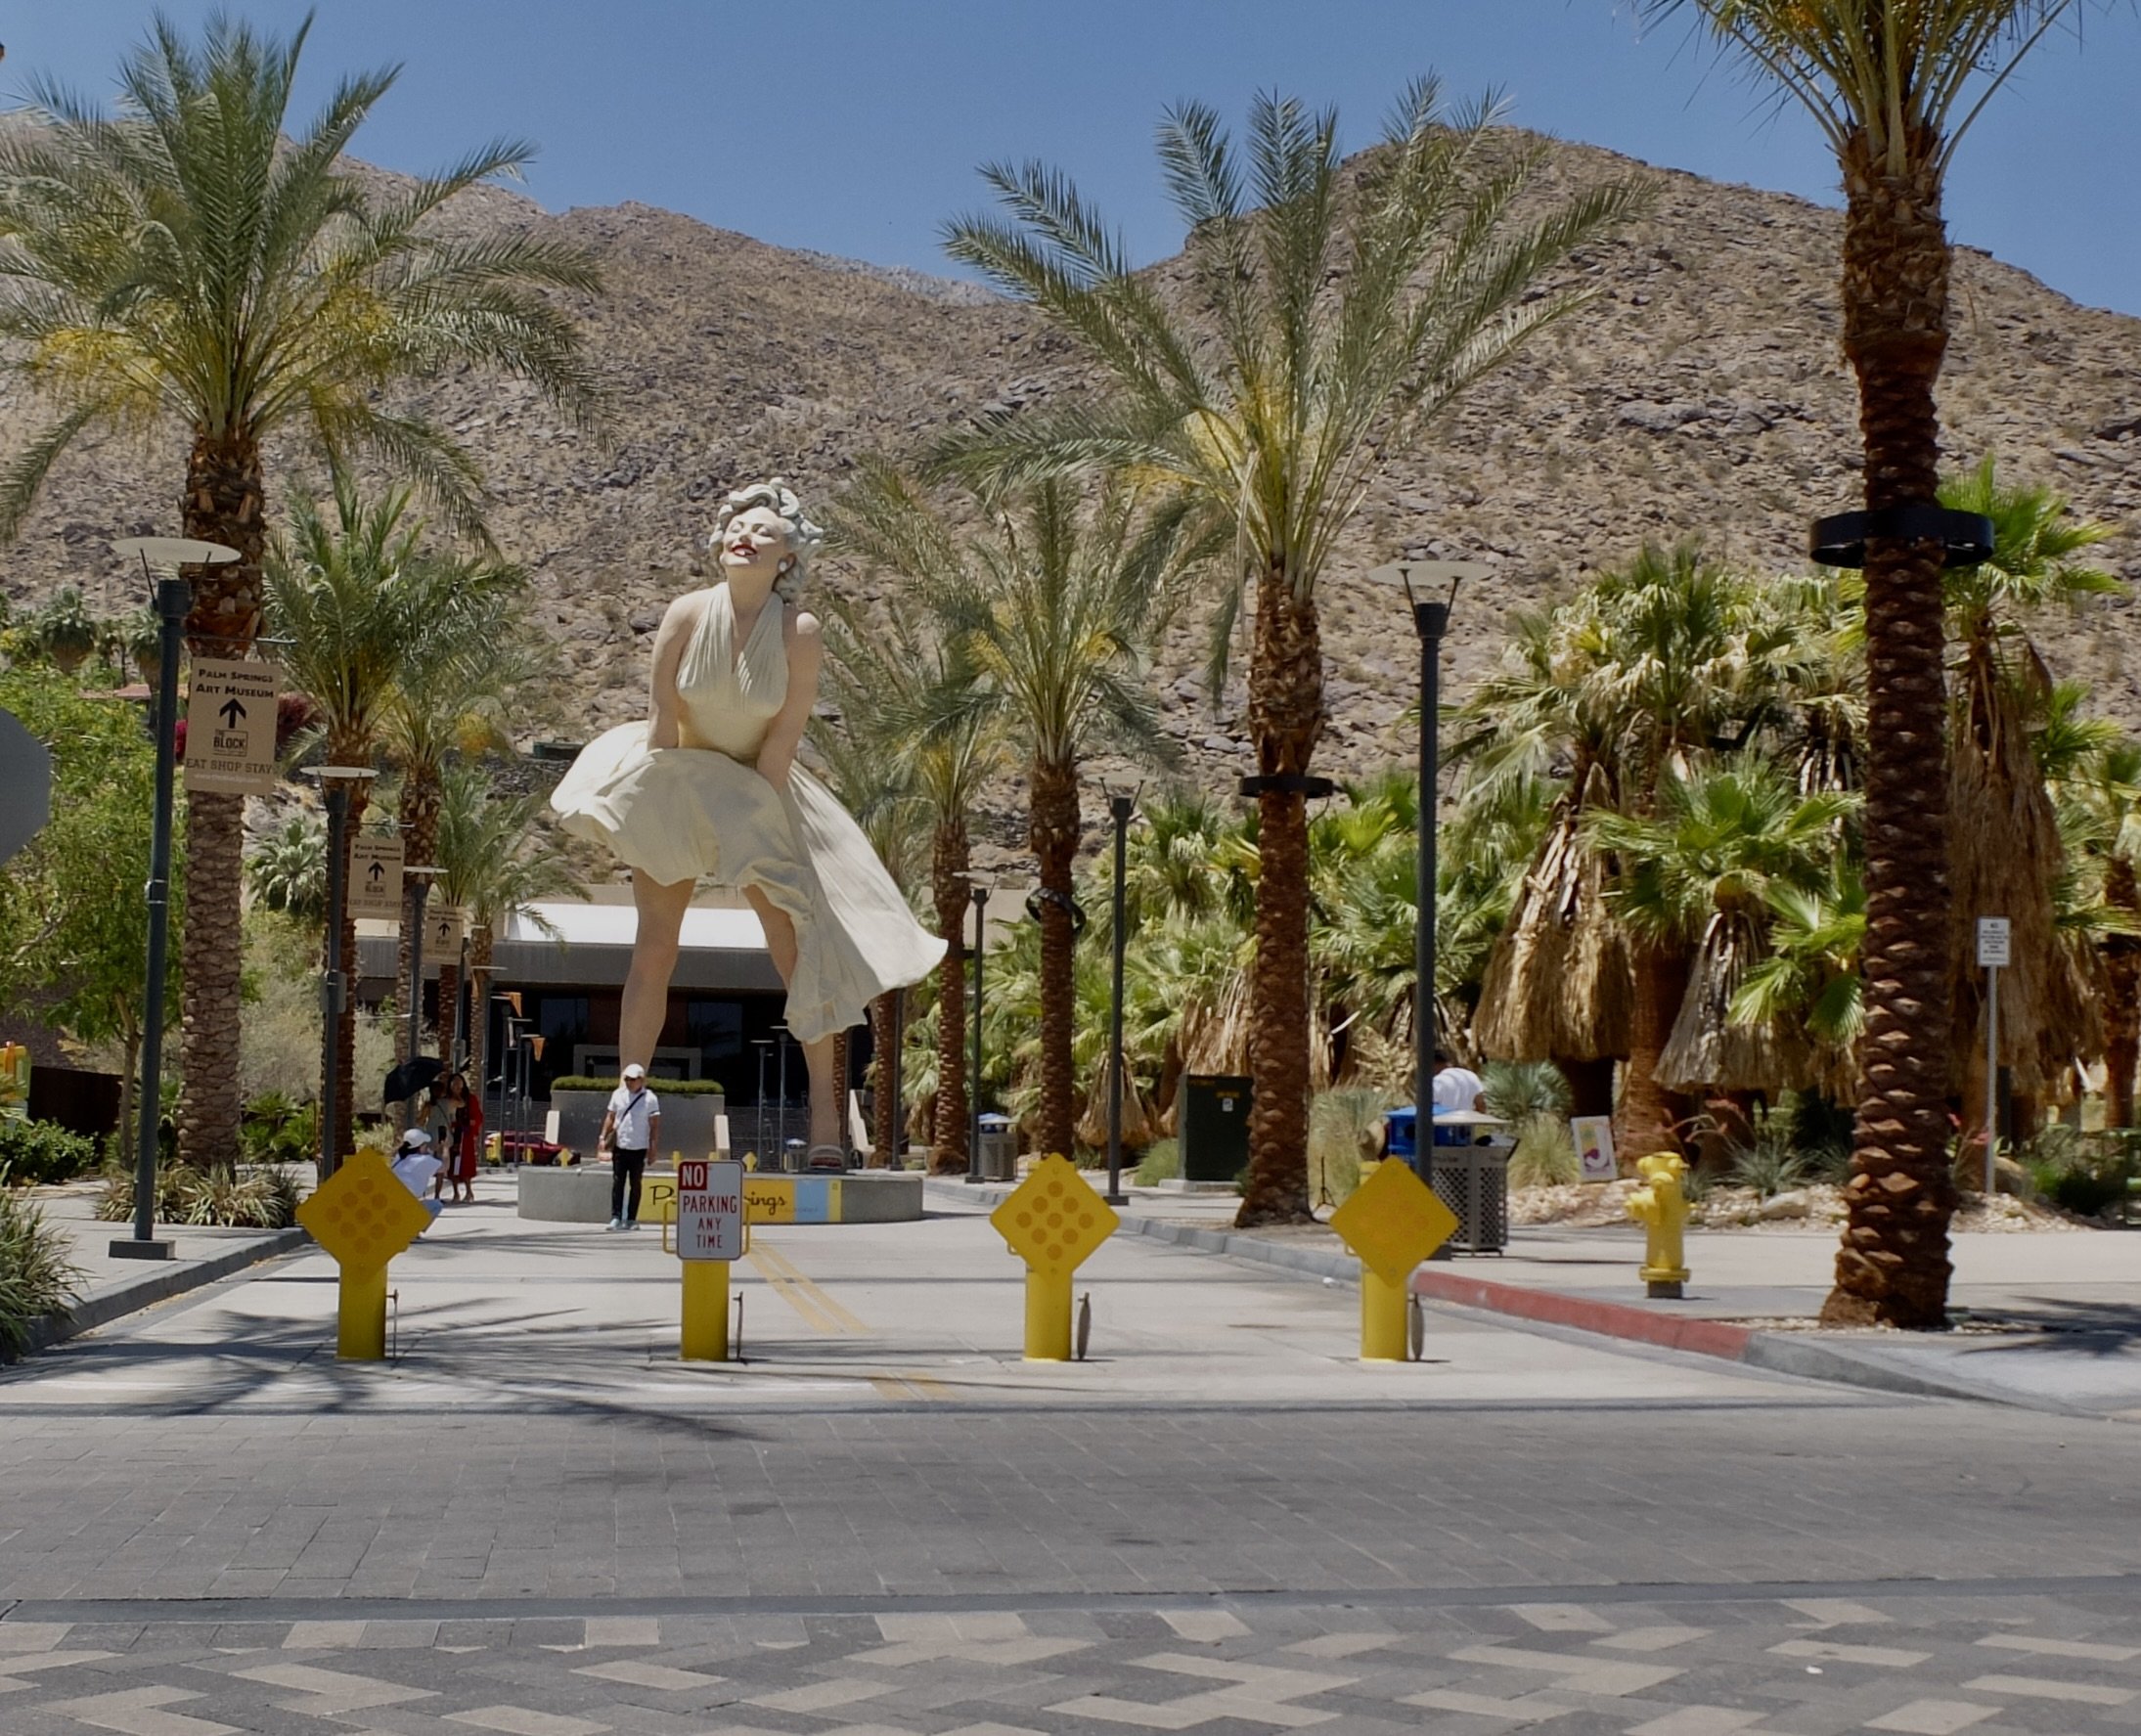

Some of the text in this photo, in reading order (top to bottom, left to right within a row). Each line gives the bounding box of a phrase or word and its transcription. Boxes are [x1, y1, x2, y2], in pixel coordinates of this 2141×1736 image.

[199, 669, 274, 683] PALM SPRINGS
[196, 684, 274, 698] ART MUSEUM
[213, 735, 245, 749] BLOCK
[186, 758, 273, 775] EAT SHOP STAY
[682, 1164, 705, 1187] NO
[683, 1195, 737, 1214] PARKING
[697, 1218, 722, 1230] ANY
[696, 1234, 723, 1249] TIME
